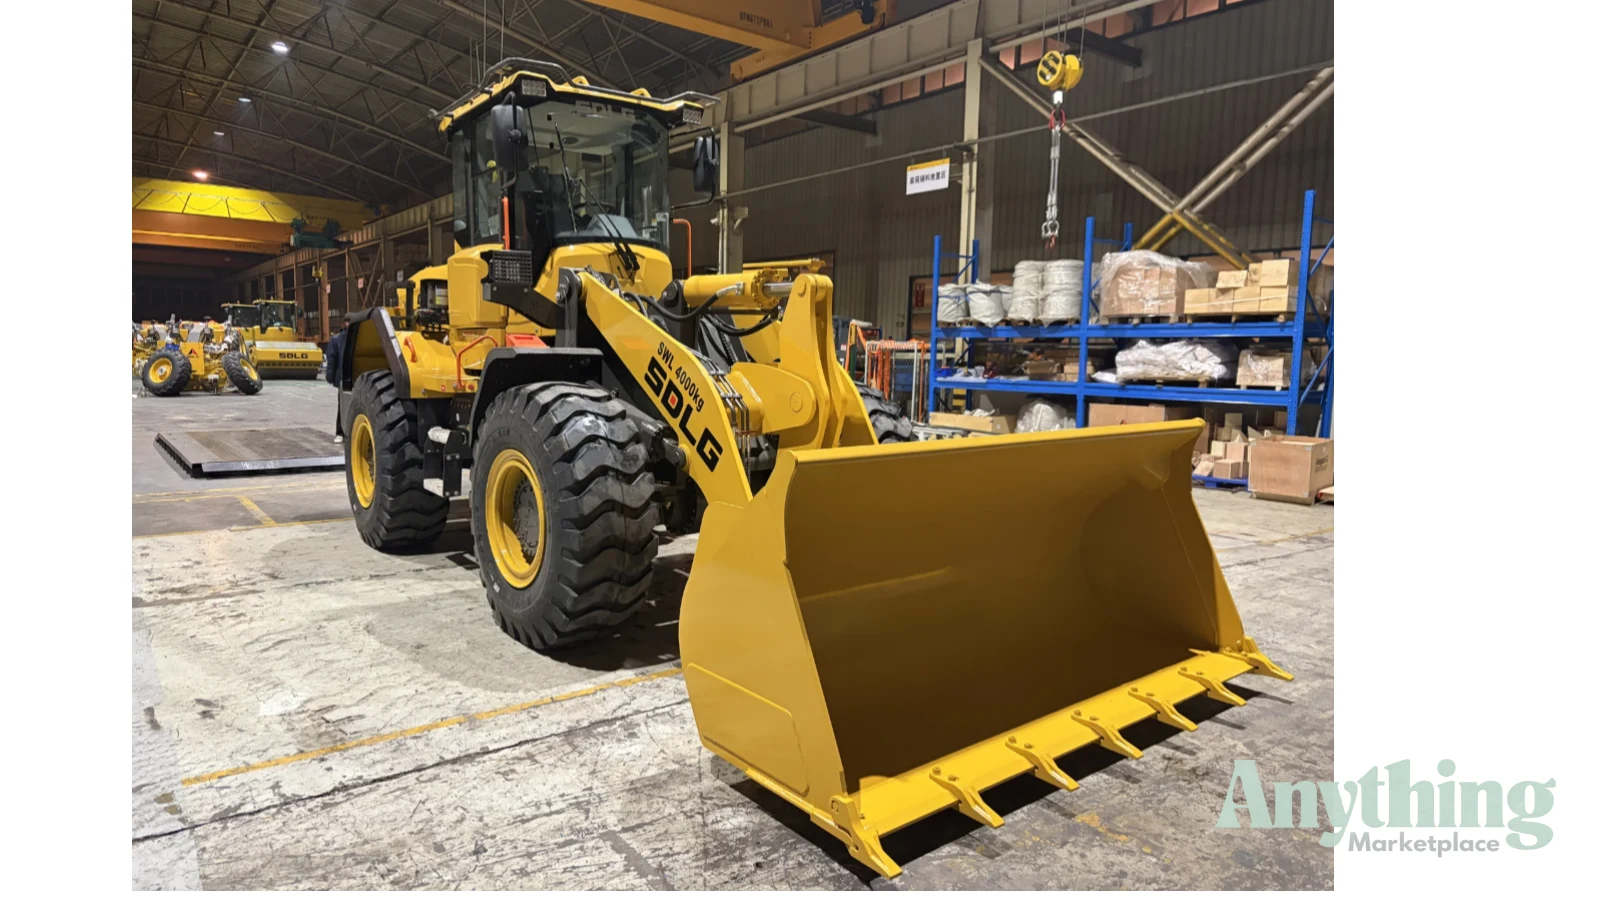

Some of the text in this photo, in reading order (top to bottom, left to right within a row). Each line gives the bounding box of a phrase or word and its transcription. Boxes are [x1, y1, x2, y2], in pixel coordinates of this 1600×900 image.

[279, 352, 308, 360] SDLG
[657, 341, 705, 413] SWL 4000kg
[644, 356, 723, 473] SDLG
